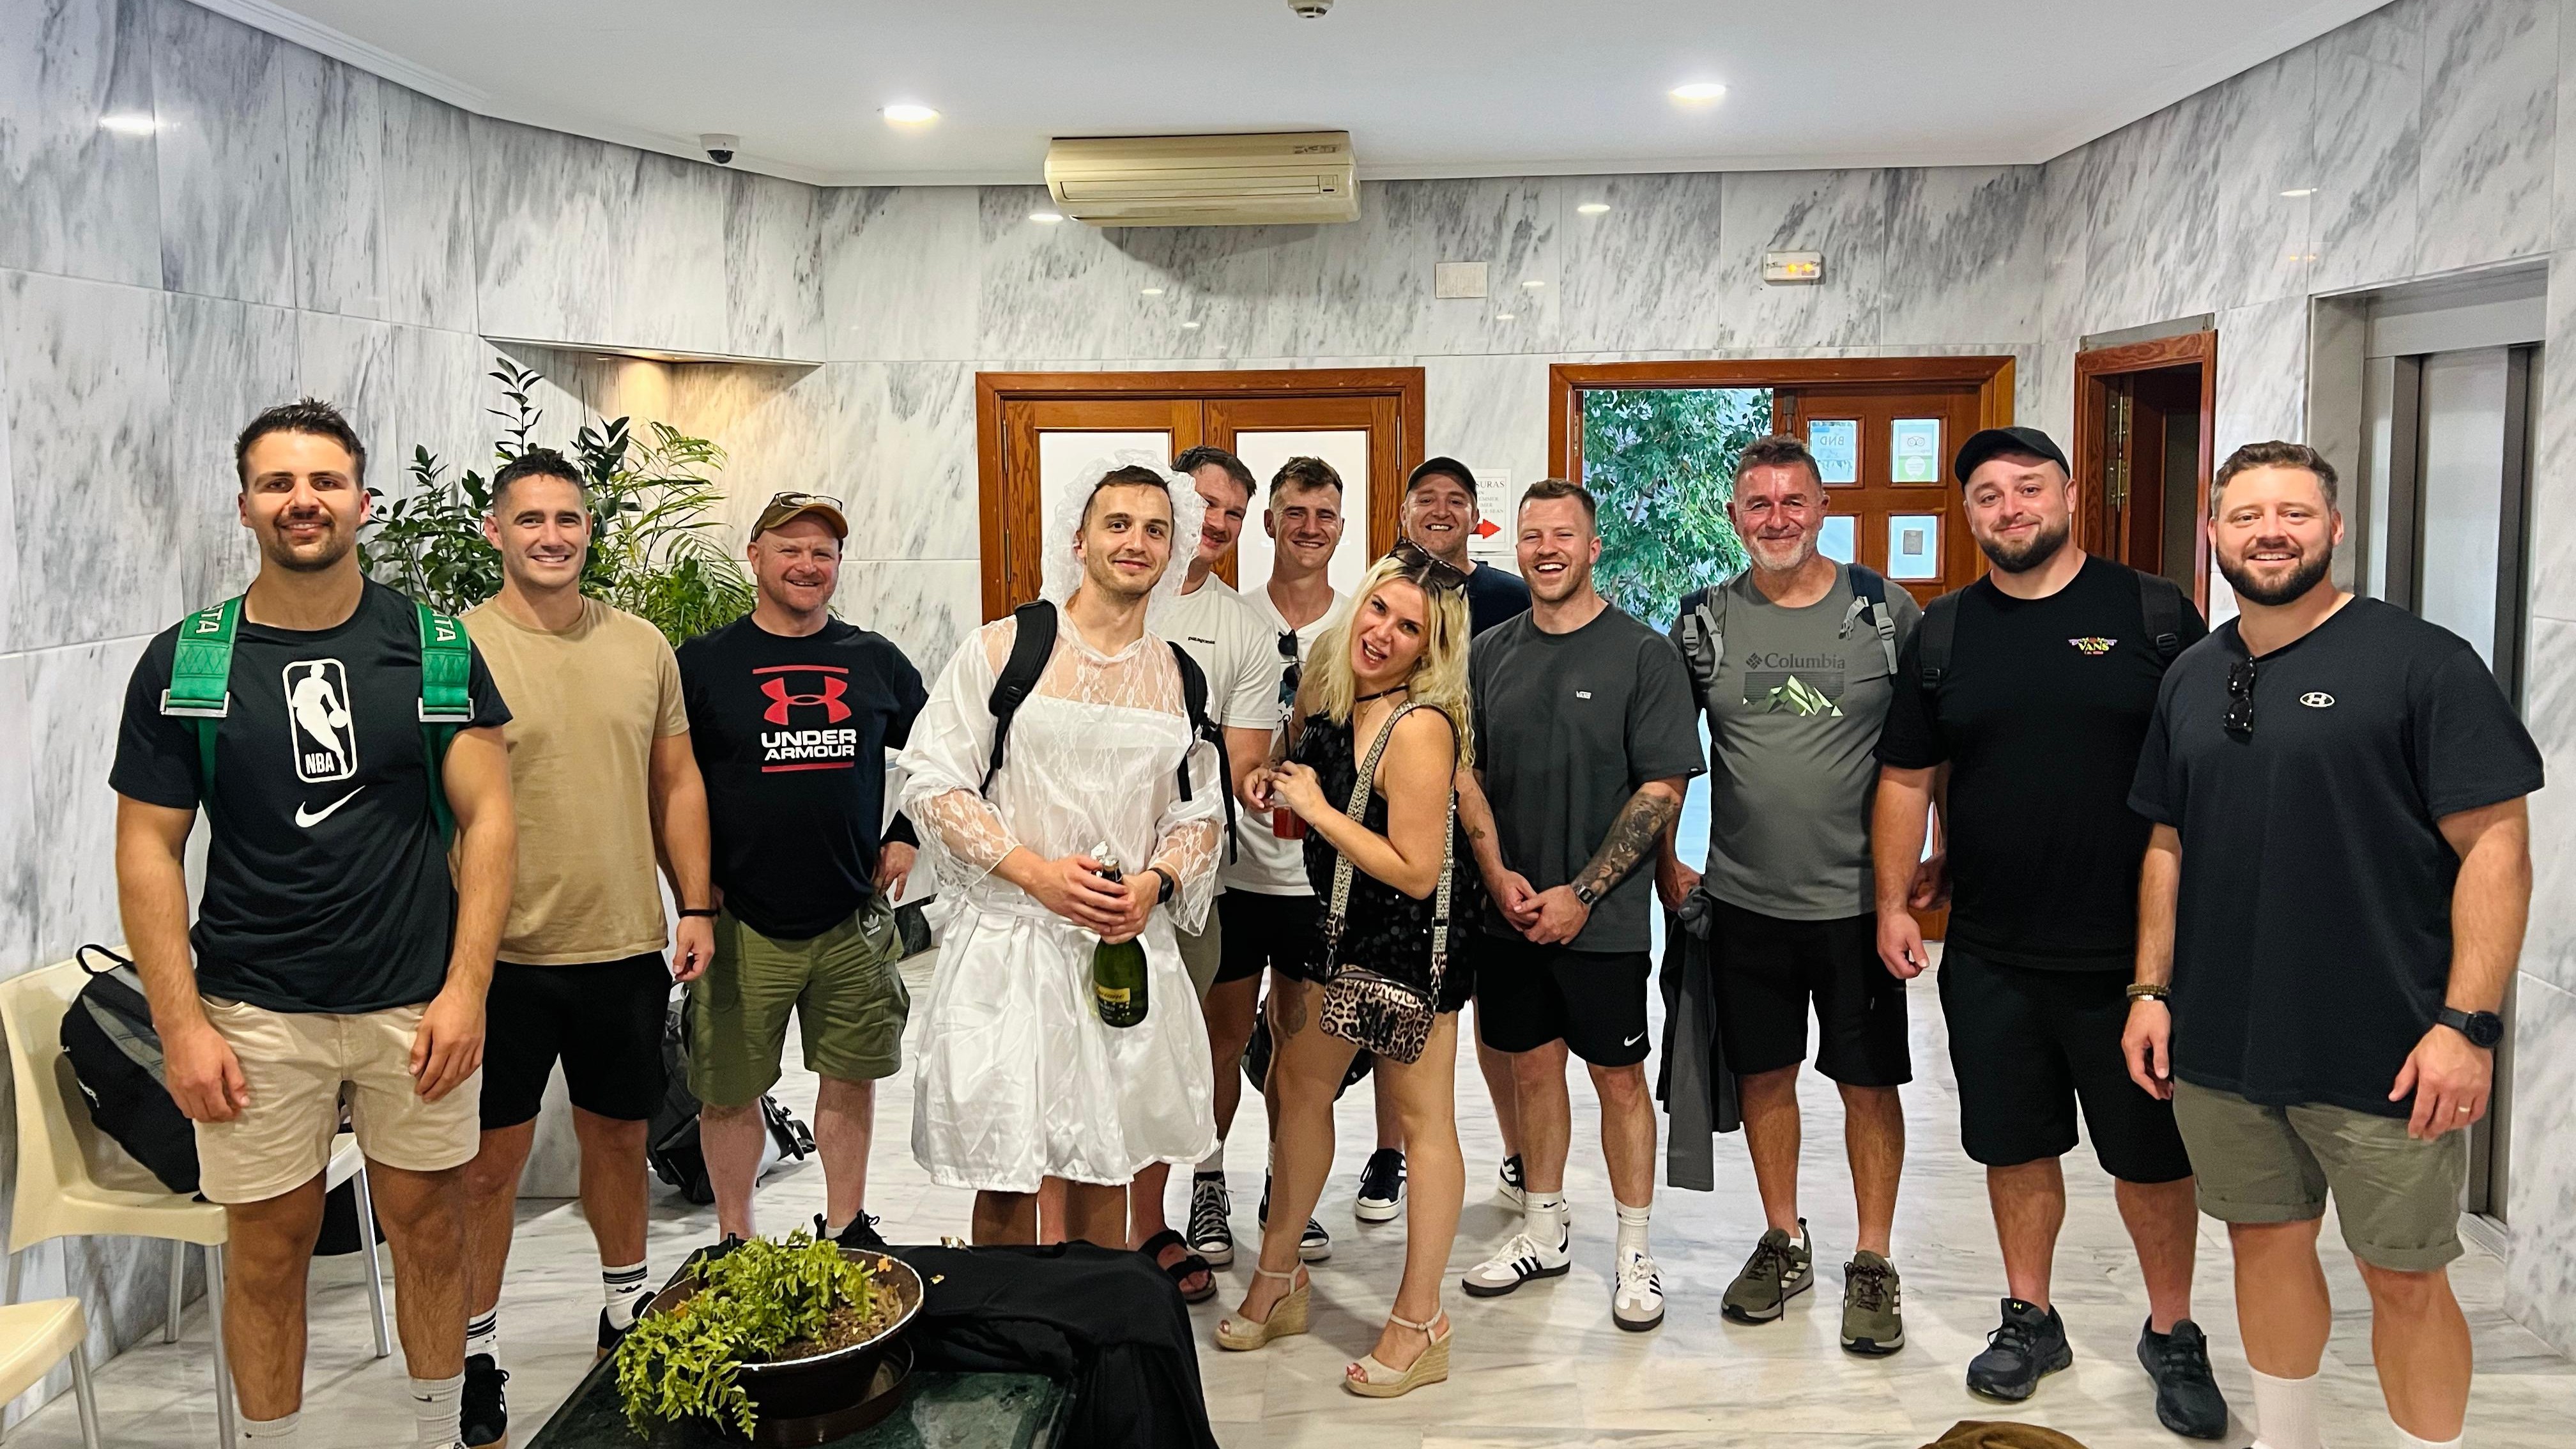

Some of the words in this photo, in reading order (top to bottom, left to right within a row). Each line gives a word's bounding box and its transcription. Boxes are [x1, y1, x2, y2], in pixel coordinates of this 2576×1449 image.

[2078, 640, 2110, 651] VANS
[1764, 652, 1845, 669] Columbia
[760, 728, 857, 748] UNDER
[764, 744, 855, 761] ARMOUR
[305, 752, 335, 774] NBA
